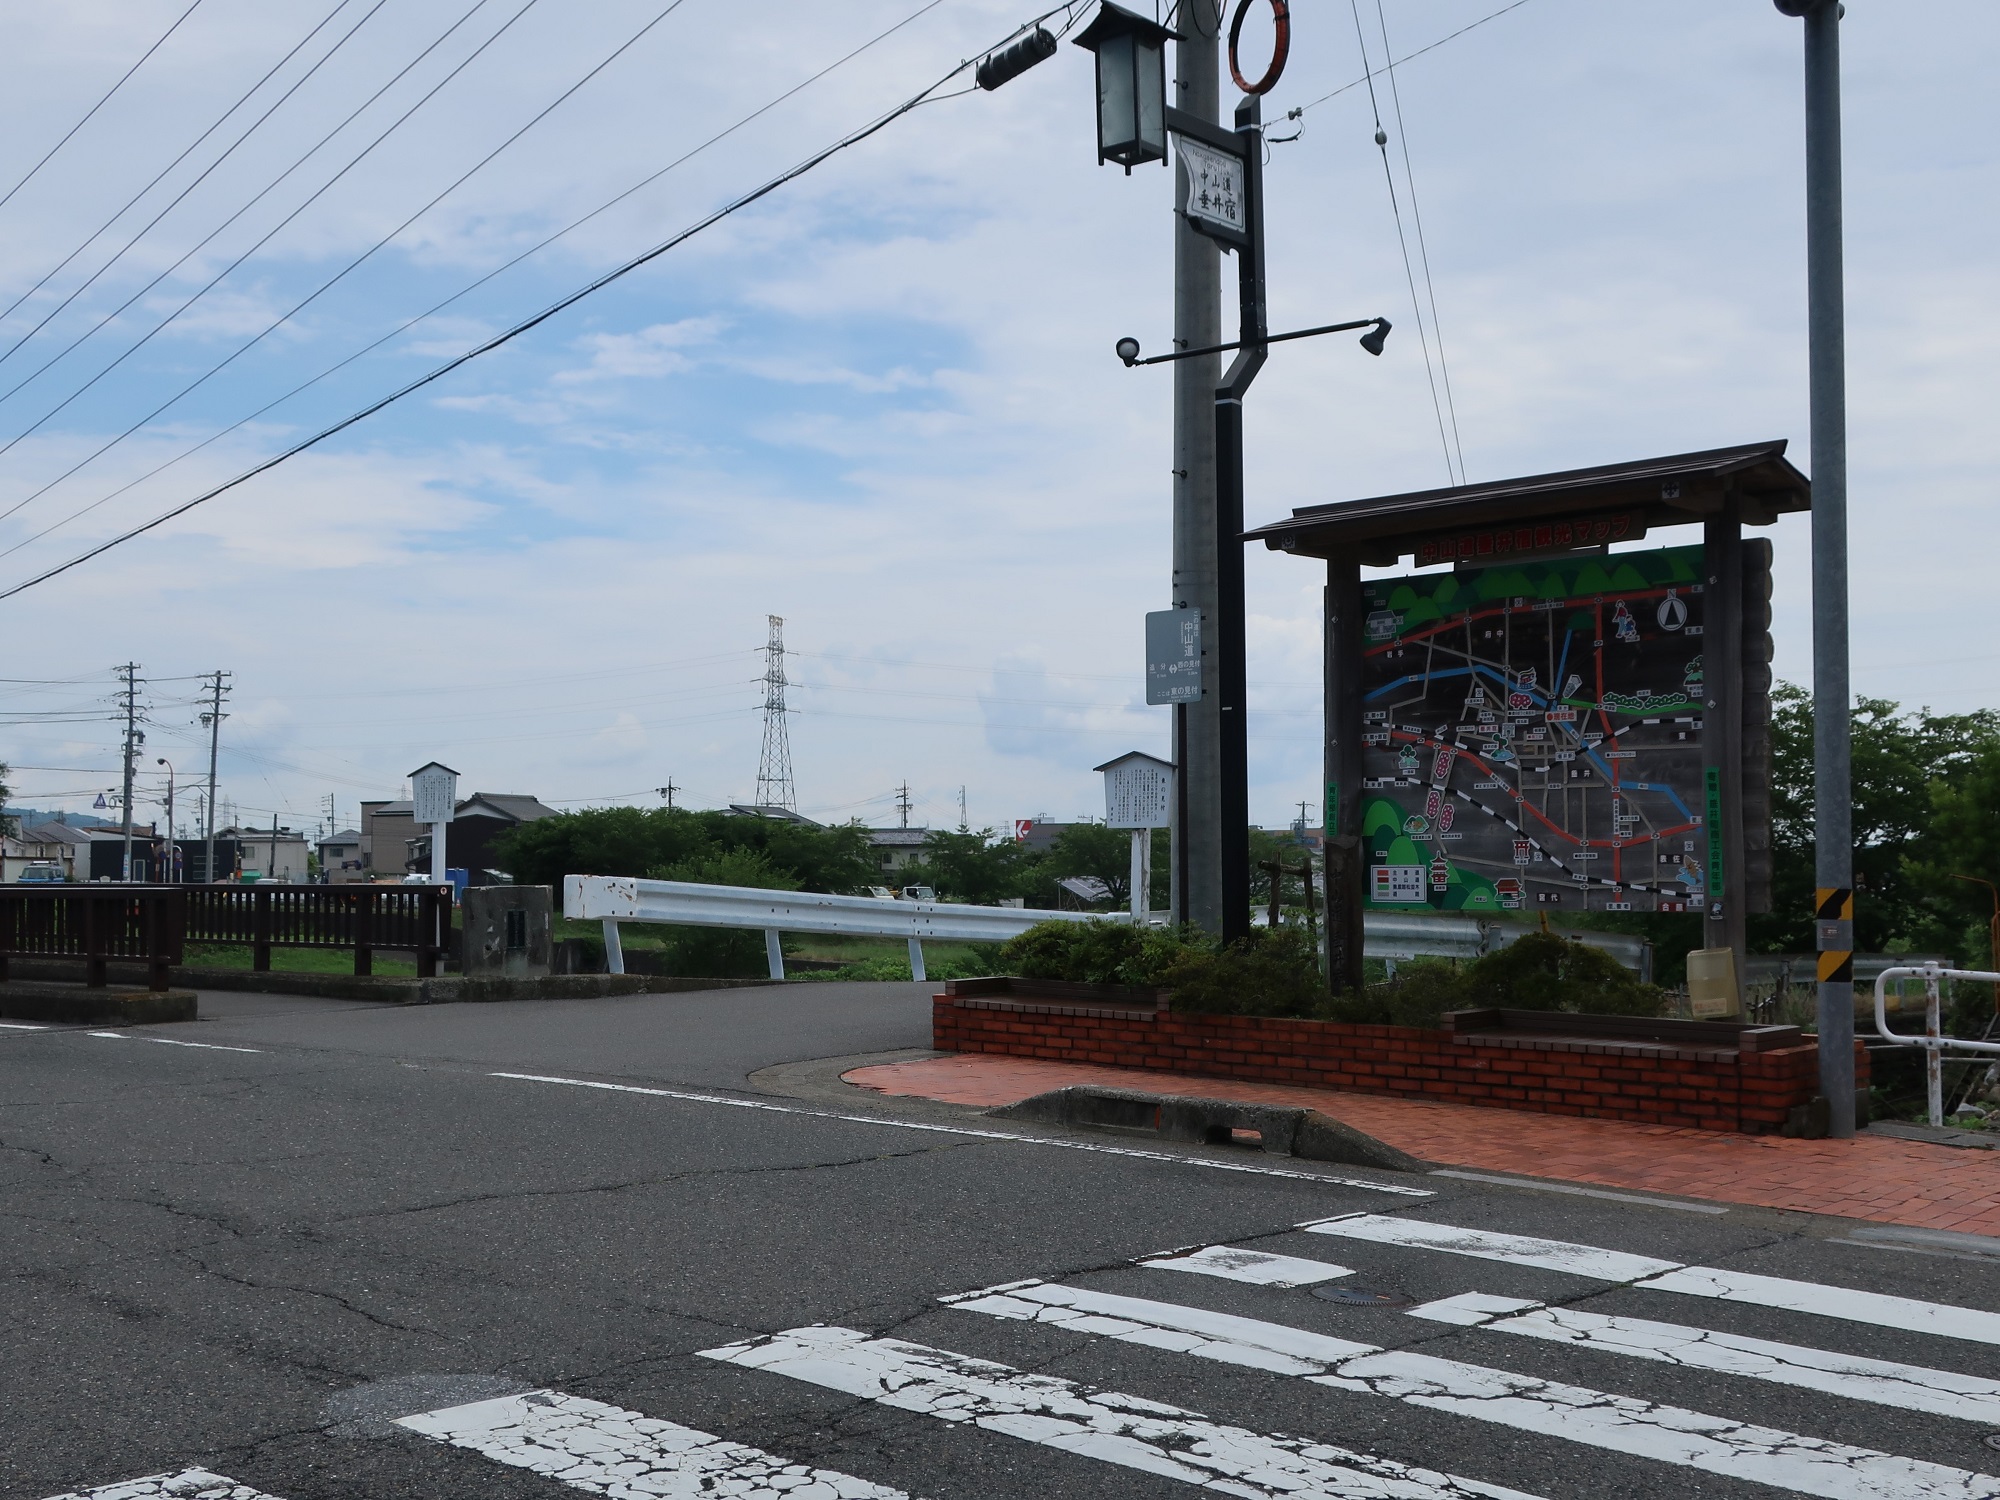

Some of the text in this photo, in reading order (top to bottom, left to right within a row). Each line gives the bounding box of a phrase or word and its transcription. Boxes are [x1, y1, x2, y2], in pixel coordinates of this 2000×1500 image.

[1201, 168, 1232, 196] 中山道
[1198, 189, 1236, 220] 垂井宿
[1422, 514, 1630, 561] 中山道垂井宿観光マップ
[1184, 621, 1194, 657] 中山道
[1171, 686, 1198, 696] 東の見付
[1553, 713, 1575, 721] 現在地
